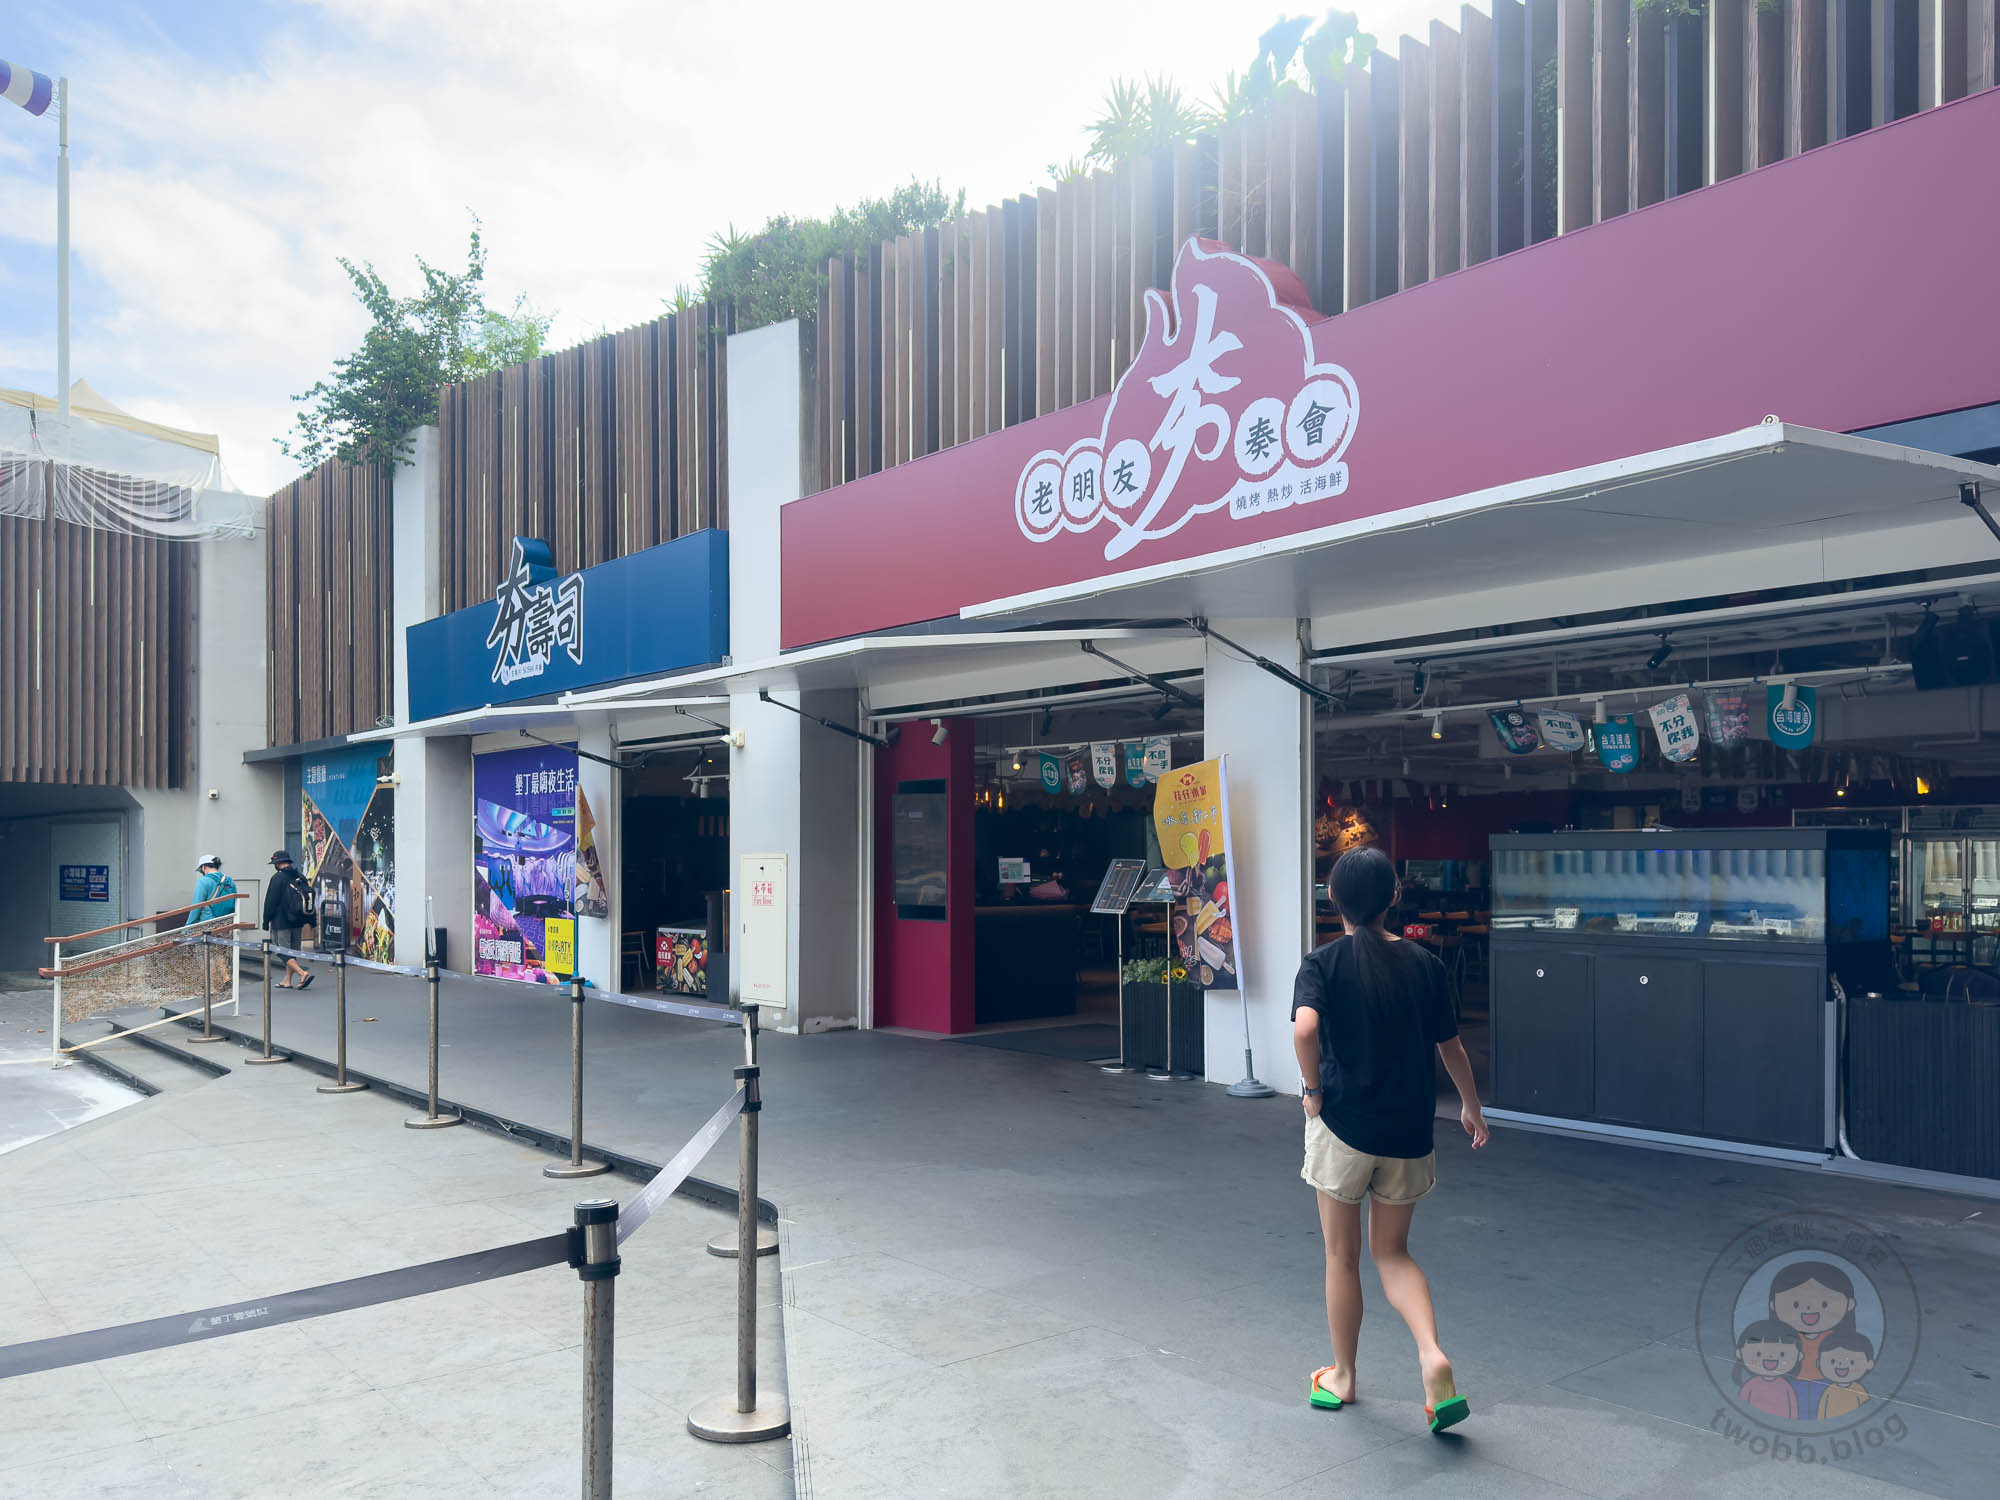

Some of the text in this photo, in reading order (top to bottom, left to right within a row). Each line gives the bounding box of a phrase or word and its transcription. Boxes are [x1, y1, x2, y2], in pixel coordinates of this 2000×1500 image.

[1031, 283, 1335, 561] 老朋友 夯 奏會
[1236, 471, 1343, 511] 燒烤 熱炒 活海鮮
[1659, 714, 1685, 733] 不分
[1667, 725, 1694, 746] 你我
[1095, 757, 1111, 765] 不分
